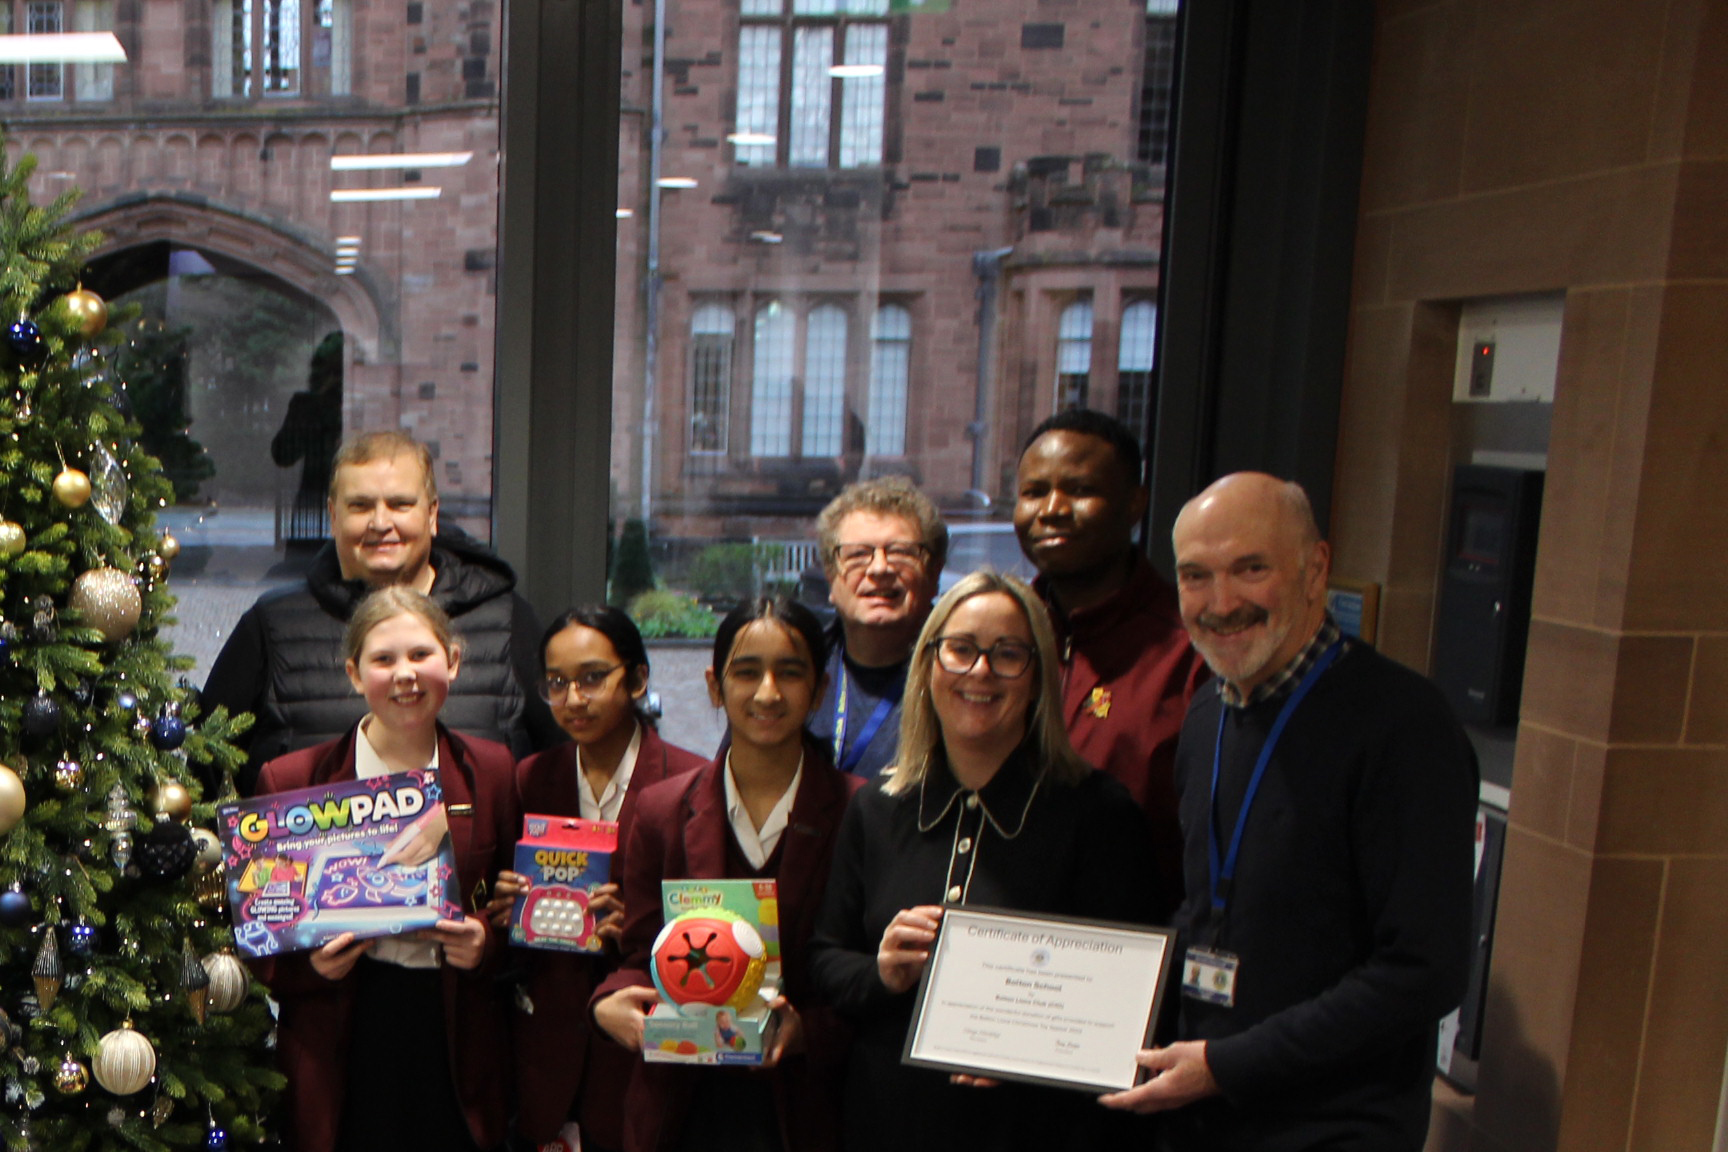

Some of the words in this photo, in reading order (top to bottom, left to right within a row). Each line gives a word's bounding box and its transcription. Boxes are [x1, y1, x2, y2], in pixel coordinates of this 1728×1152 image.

[276, 839, 302, 852] Bring
[302, 836, 326, 849] your
[326, 829, 367, 846] pictures
[367, 827, 379, 837] to
[380, 823, 398, 835] life!
[324, 856, 367, 875] WOW!
[535, 850, 588, 866] QUICK
[543, 866, 579, 882] POP
[968, 926, 1029, 944] Certificate
[1032, 933, 1043, 944] of
[1045, 935, 1123, 956] Appreciation
